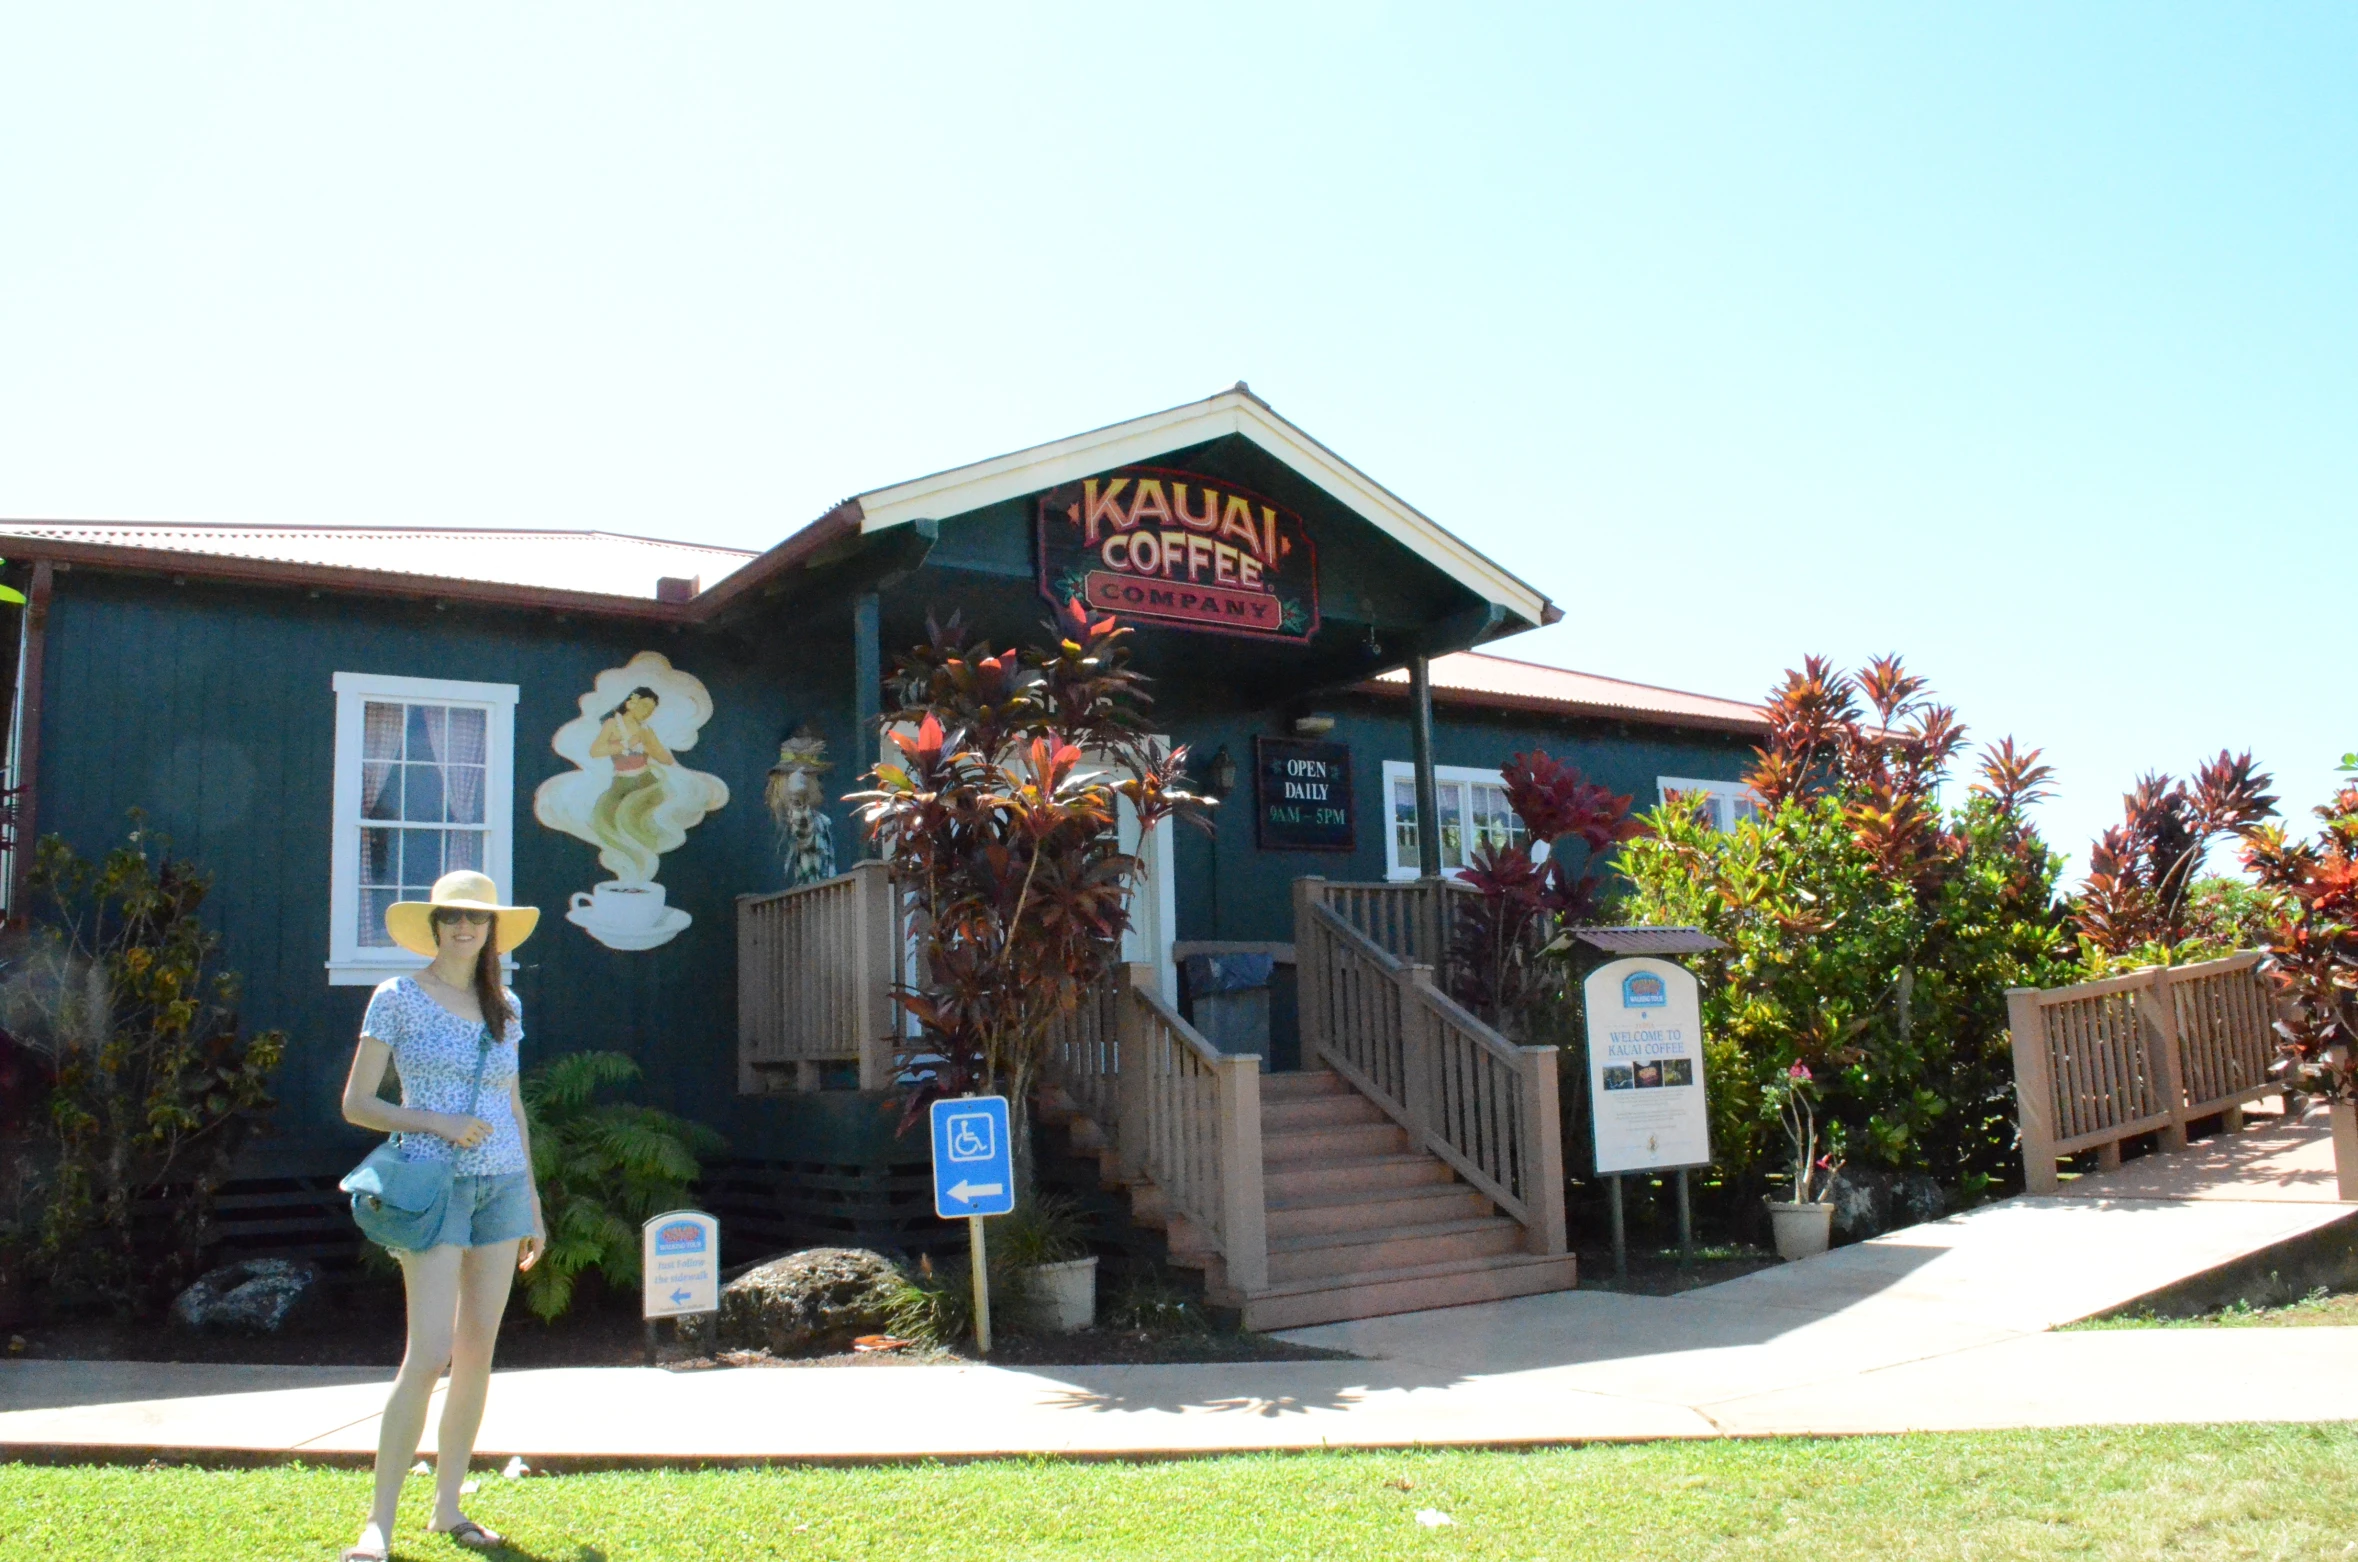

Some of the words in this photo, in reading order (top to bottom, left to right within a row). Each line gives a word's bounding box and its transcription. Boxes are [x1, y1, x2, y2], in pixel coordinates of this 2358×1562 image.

[1083, 478, 1278, 571] KAUAI
[1102, 531, 1264, 590] COFFEE
[1100, 583, 1269, 619] COMPANY
[1287, 759, 1326, 778] OPEN
[1285, 781, 1329, 800] DAILY
[1270, 805, 1300, 823] 9AM
[1316, 808, 1345, 825] 5PM
[1610, 1030, 1663, 1043] WELCOME
[1666, 1029, 1681, 1041] TO
[1609, 1044, 1641, 1056] KAUAI
[1645, 1042, 1684, 1055] COFFEE
[654, 1275, 668, 1284] the
[671, 1271, 708, 1283] sidewalk
